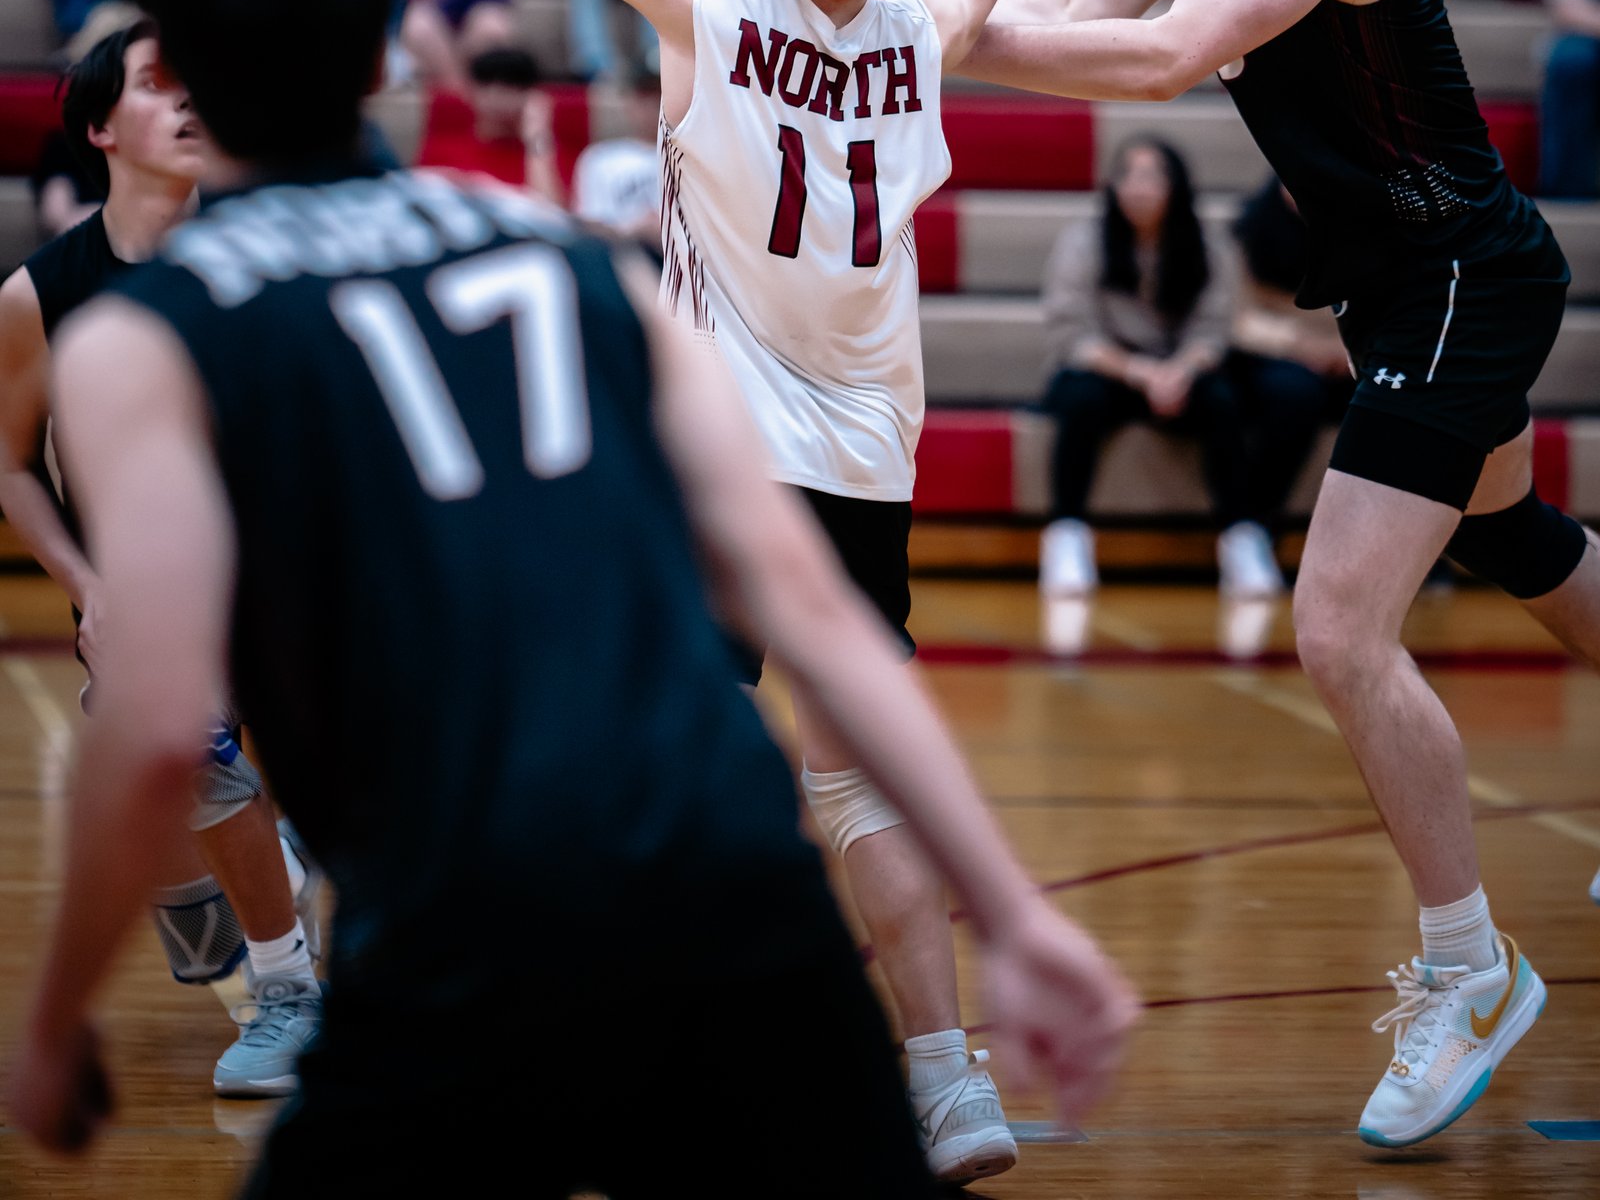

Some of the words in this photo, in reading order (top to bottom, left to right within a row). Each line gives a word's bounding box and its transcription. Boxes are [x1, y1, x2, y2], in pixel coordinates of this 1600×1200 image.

[729, 17, 922, 122] NORTH
[767, 123, 882, 267] 11
[329, 241, 593, 501] 17
[946, 1101, 1003, 1132] MIZU
